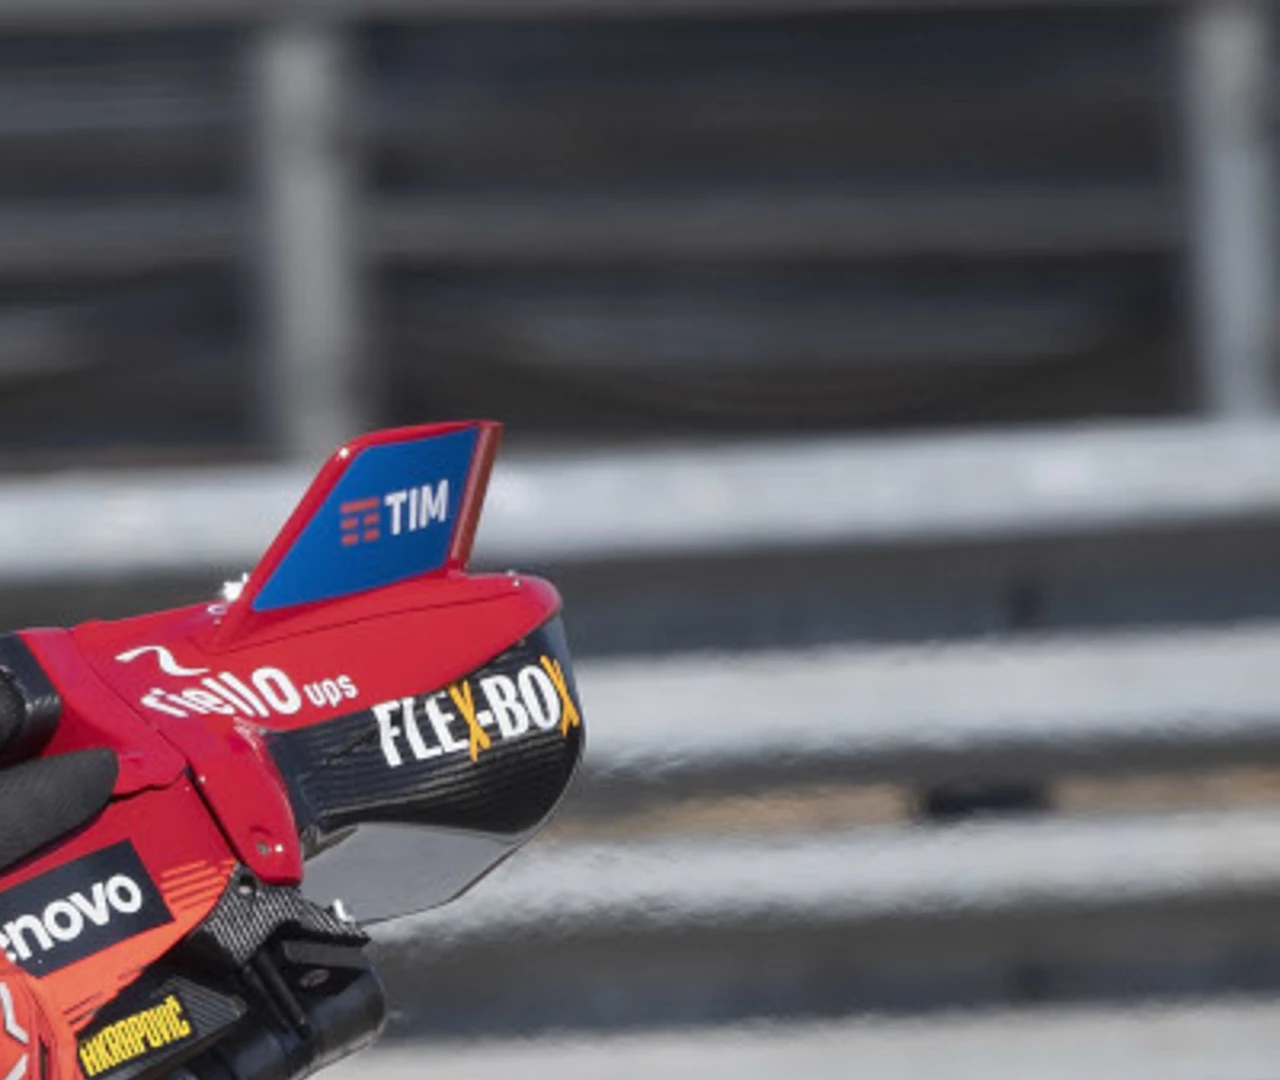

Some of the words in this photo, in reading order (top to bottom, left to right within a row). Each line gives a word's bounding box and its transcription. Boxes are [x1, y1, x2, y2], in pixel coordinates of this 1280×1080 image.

[385, 479, 449, 536] TIM
[141, 666, 303, 718] riello
[303, 673, 359, 709] ups
[372, 655, 580, 768] FLEX-BOX
